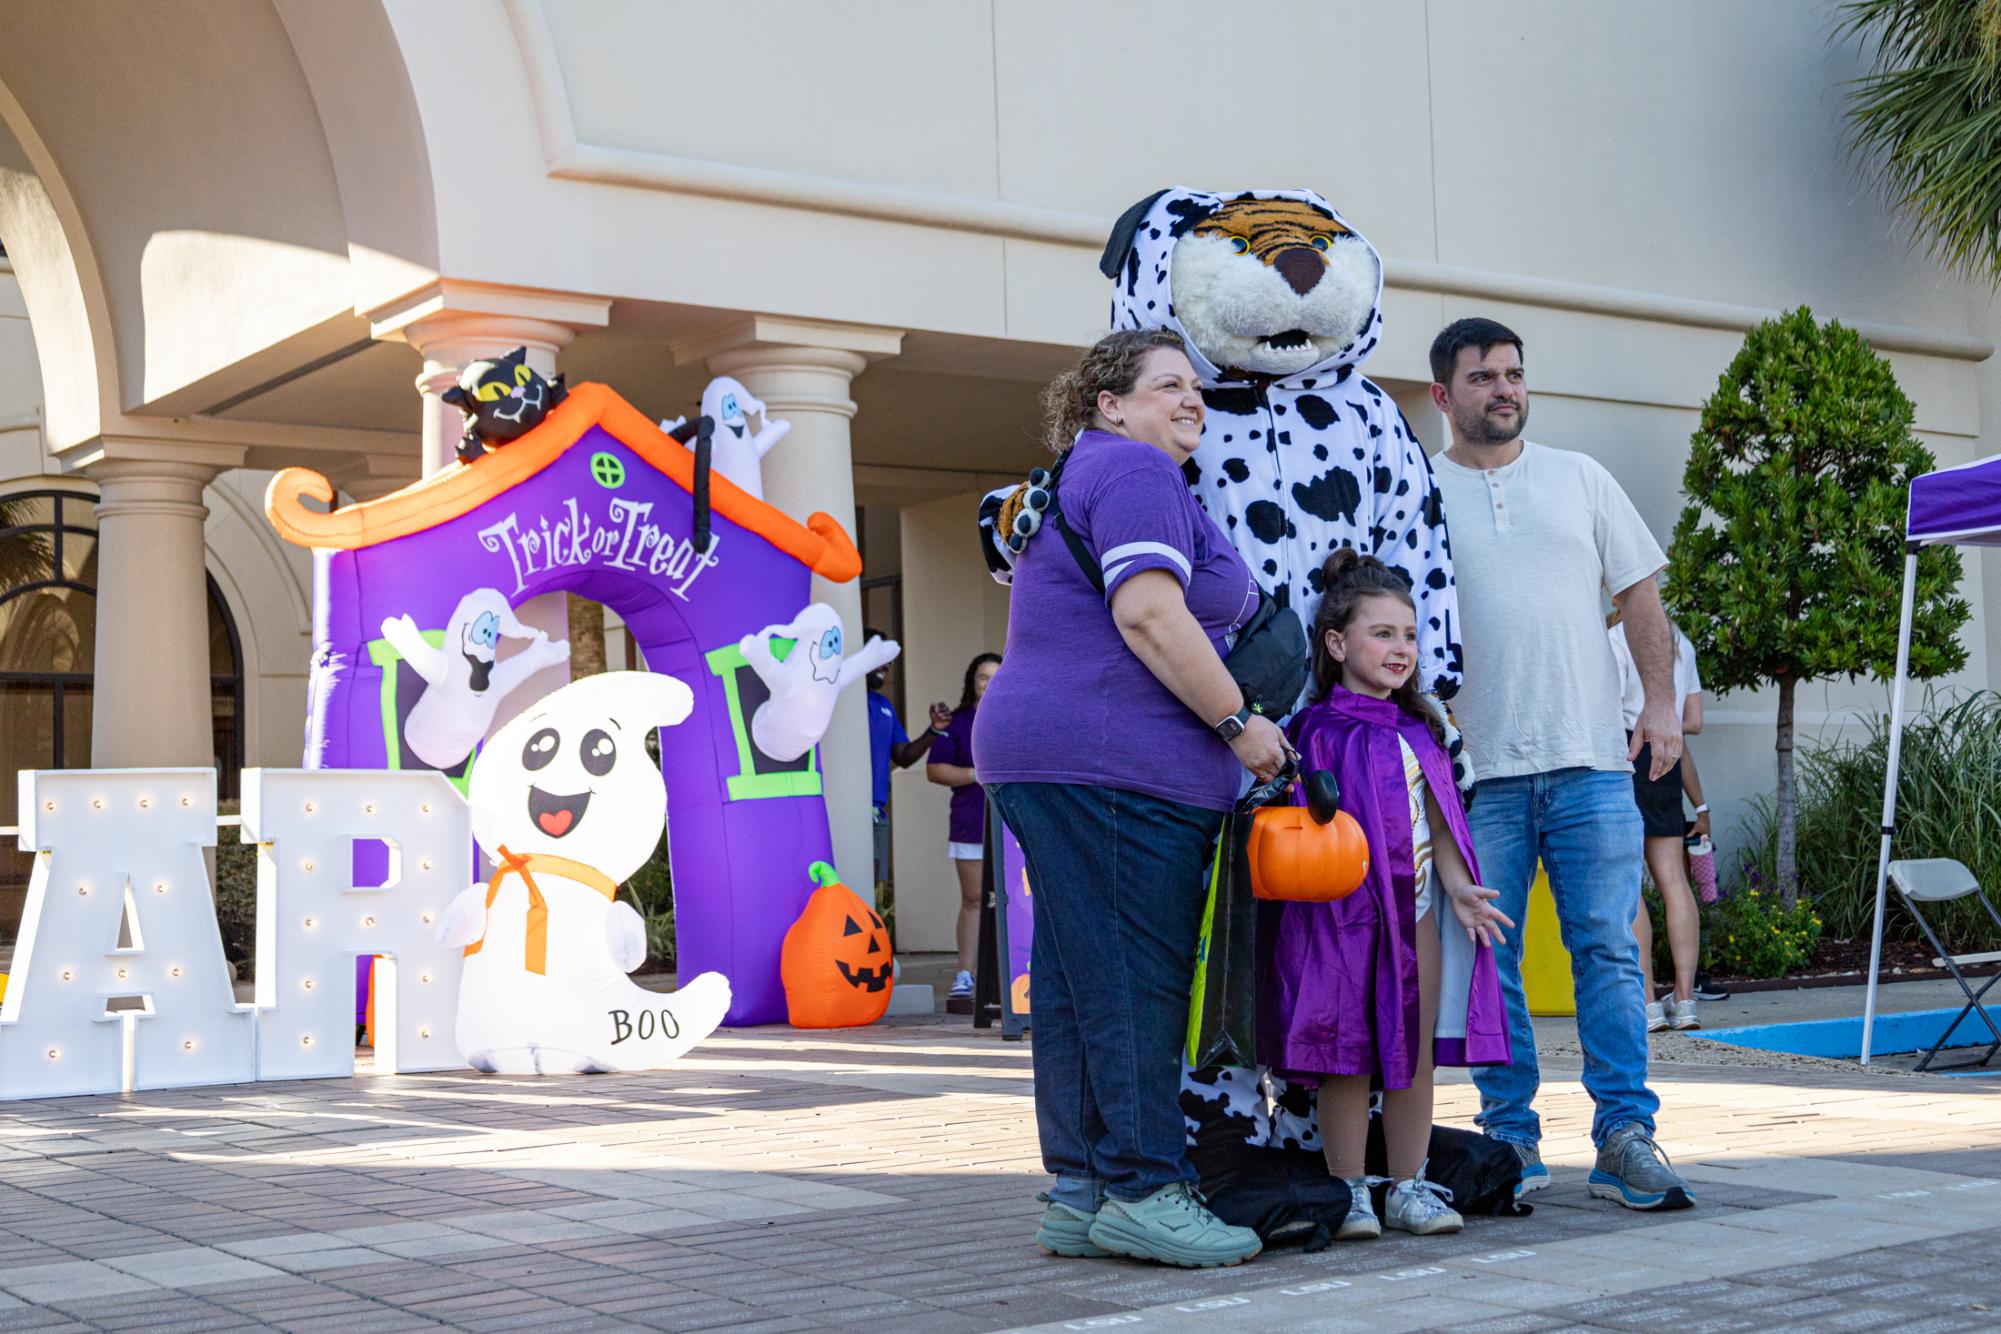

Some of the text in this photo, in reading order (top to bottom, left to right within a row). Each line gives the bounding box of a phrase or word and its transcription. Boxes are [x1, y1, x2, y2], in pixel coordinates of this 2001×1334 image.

[478, 497, 720, 602] Trick or Treat
[608, 1009, 680, 1045] BOO
